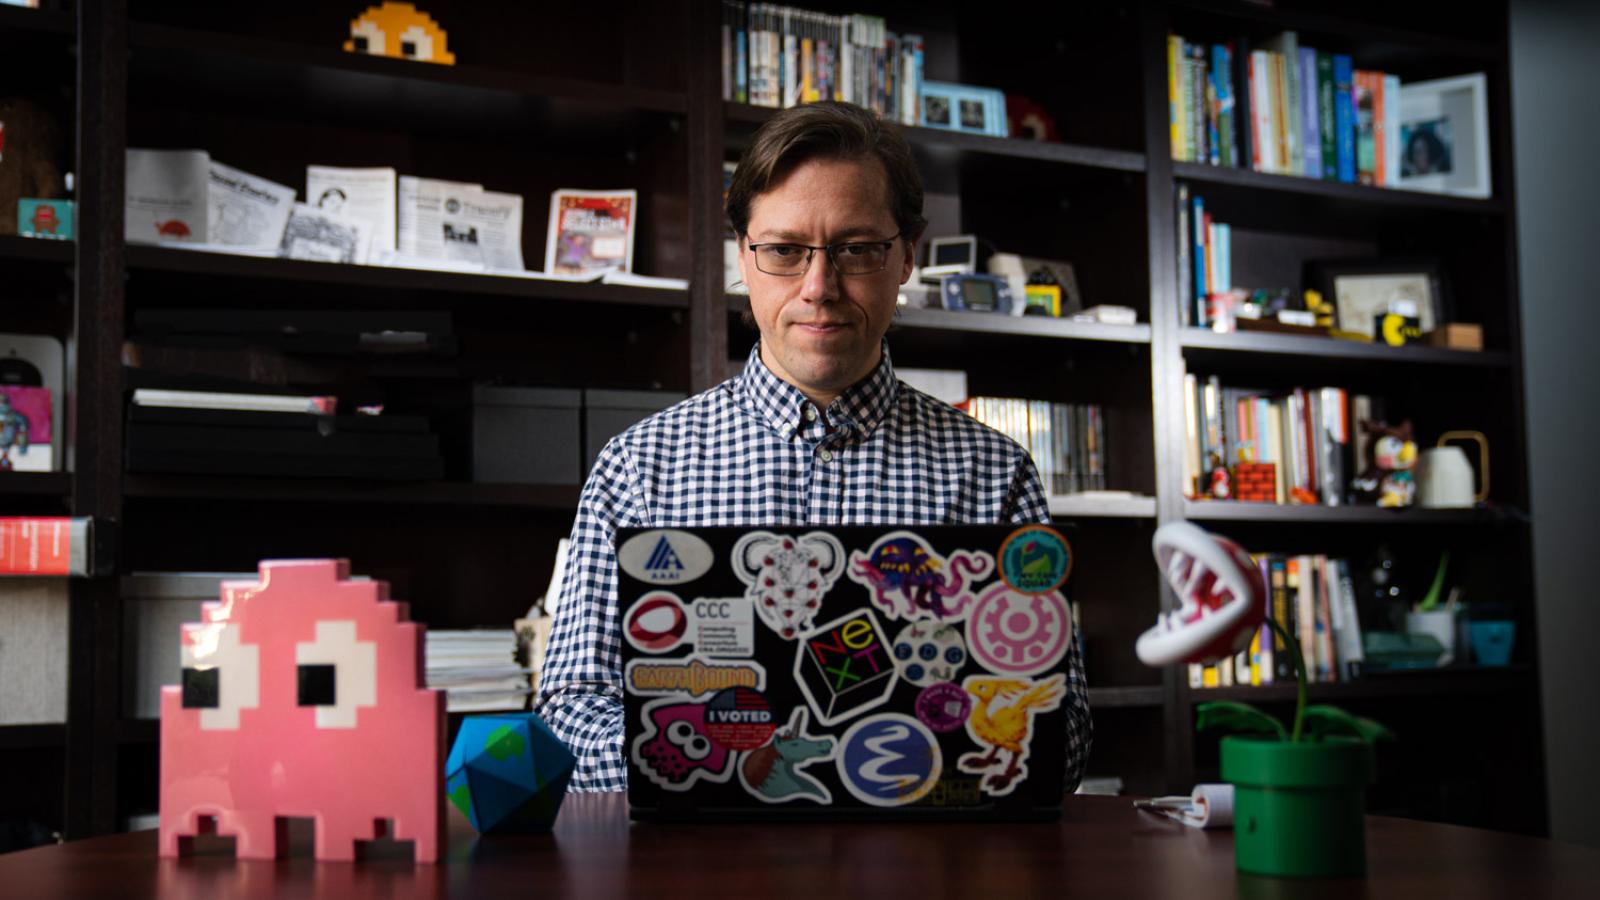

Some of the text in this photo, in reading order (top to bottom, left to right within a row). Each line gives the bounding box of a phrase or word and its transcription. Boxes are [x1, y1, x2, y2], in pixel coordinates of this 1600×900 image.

[695, 602, 731, 619] CCC
[709, 710, 771, 723] I VOTED
